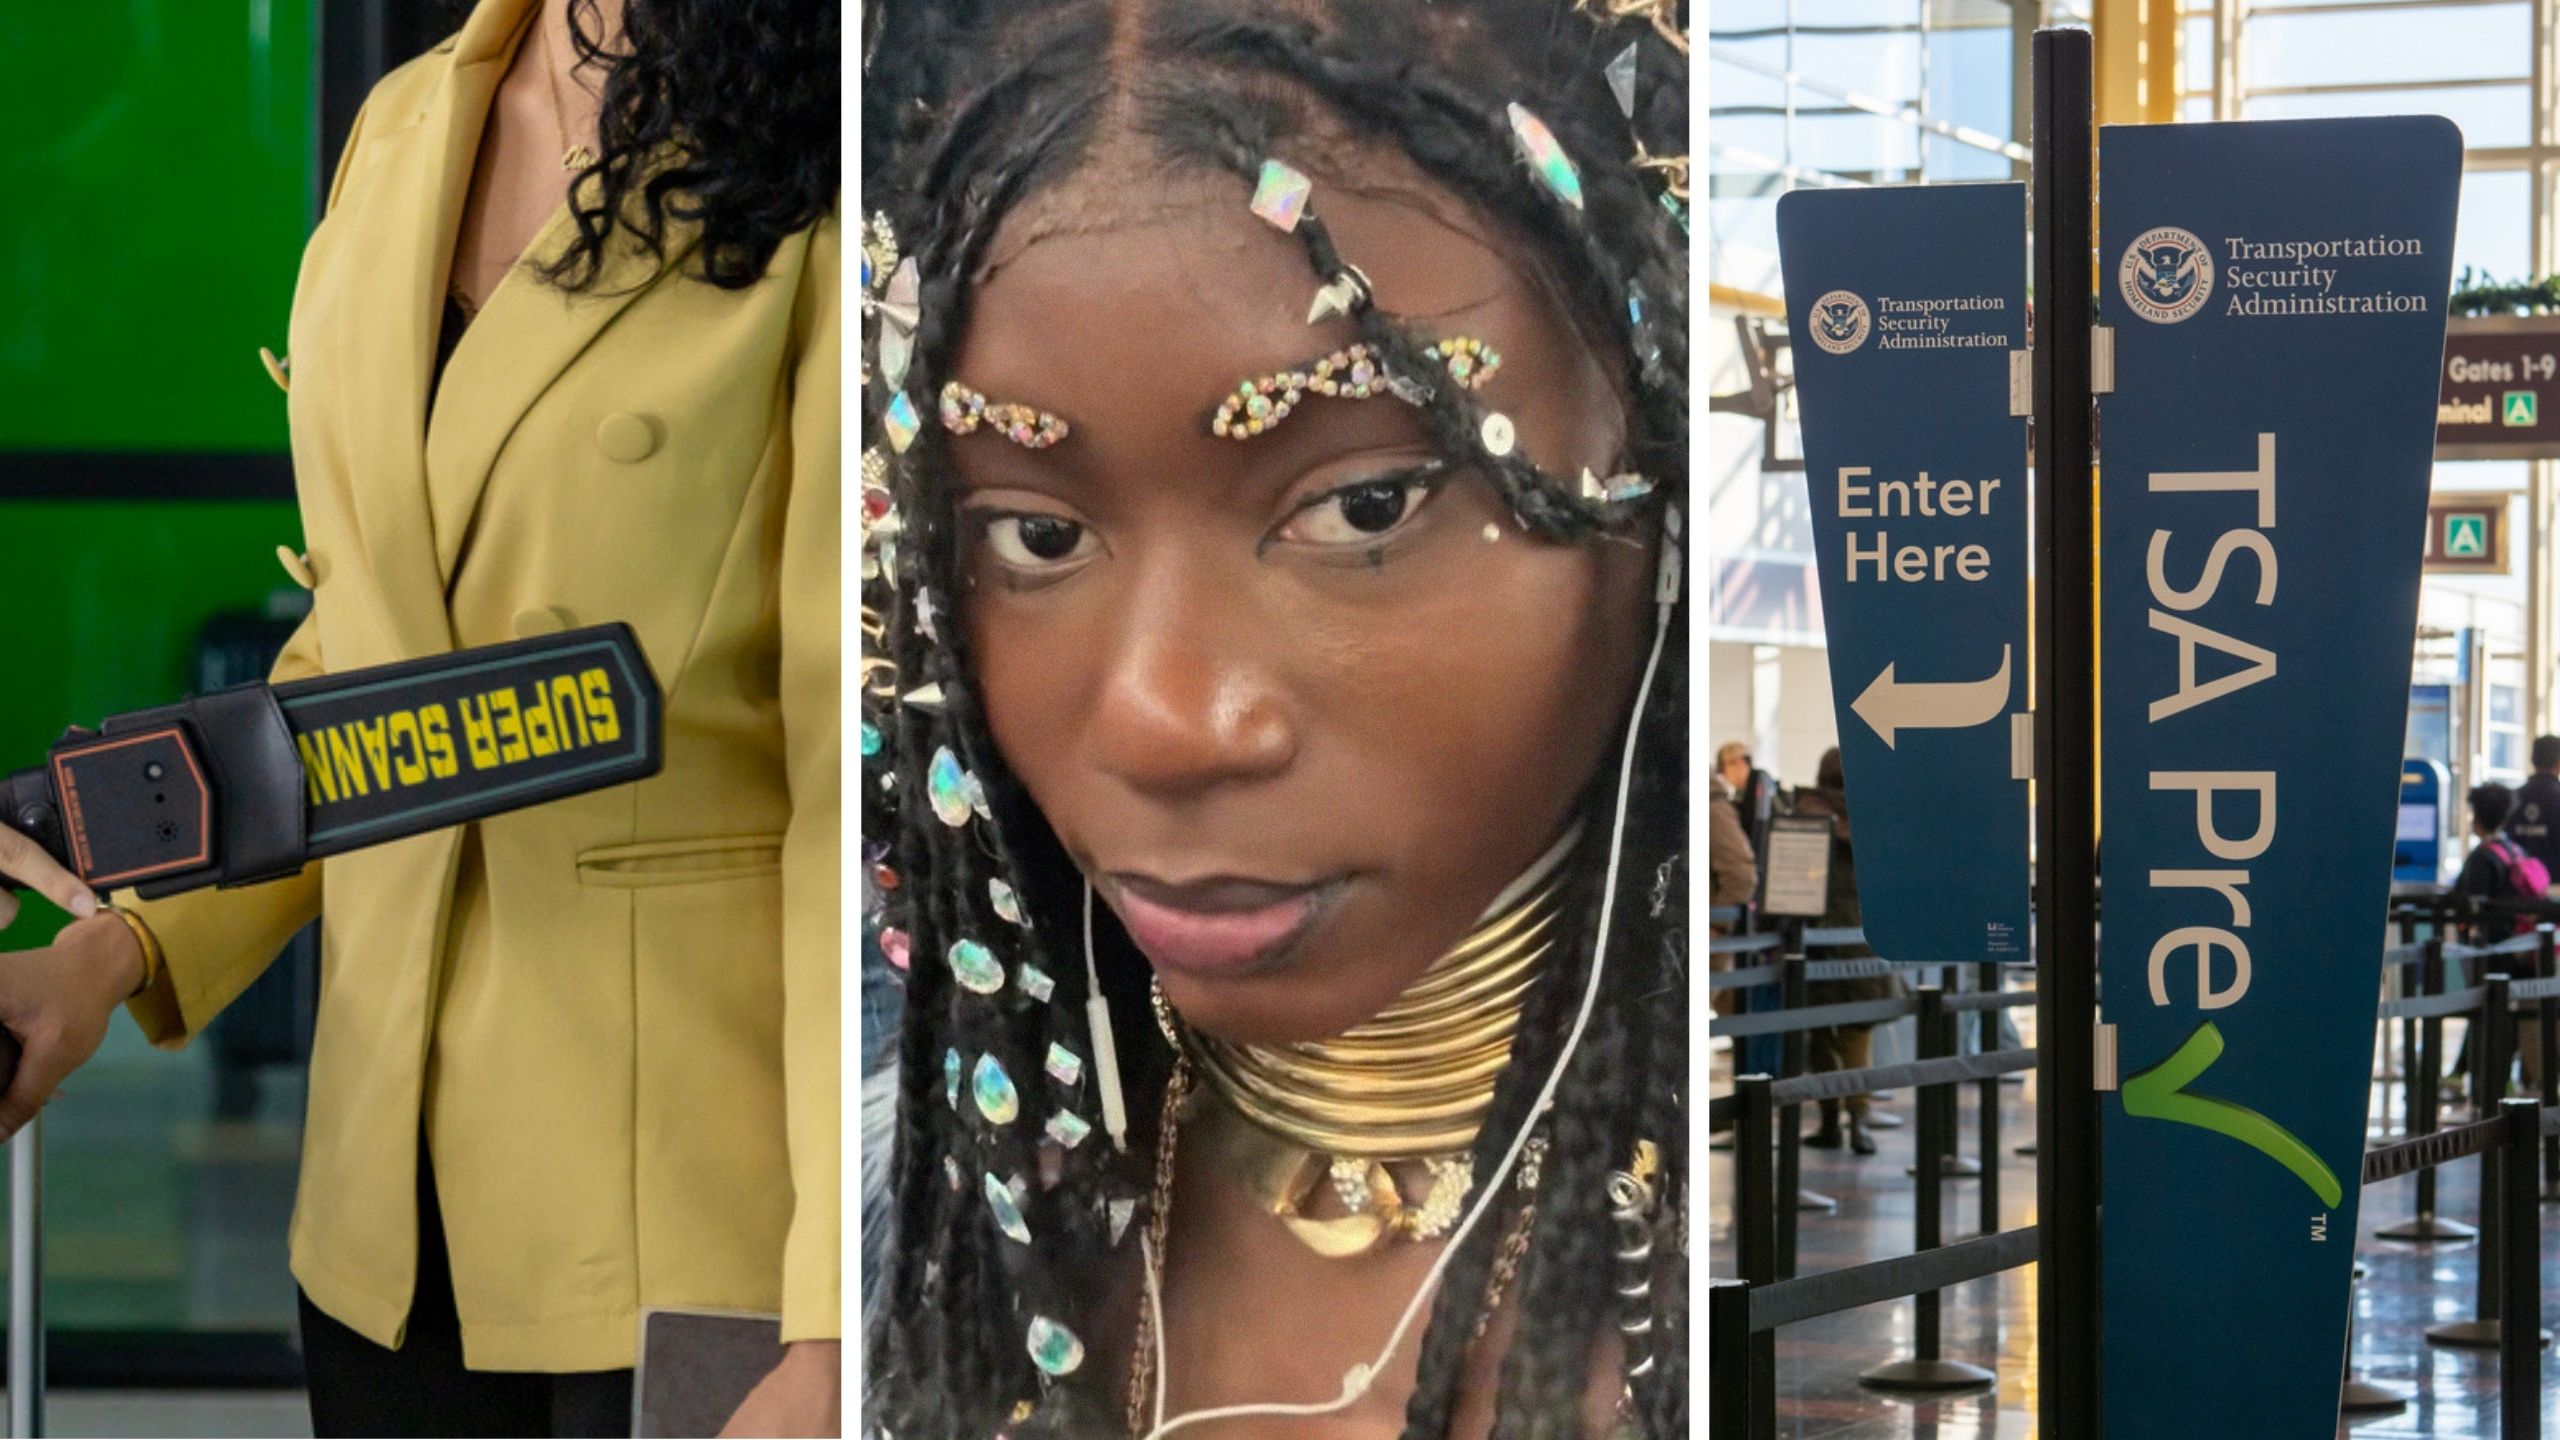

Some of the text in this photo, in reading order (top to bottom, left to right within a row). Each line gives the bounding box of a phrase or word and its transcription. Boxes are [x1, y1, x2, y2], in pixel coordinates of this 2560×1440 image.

[2225, 234, 2423, 265] Transportation
[2226, 265, 2337, 293] Security
[1877, 295, 2005, 316] Transportation
[2225, 290, 2428, 316] Administration
[1878, 315, 1950, 333] Security
[1877, 332, 2008, 350] Administration
[2448, 353, 2556, 383] Gates 1-9
[1838, 466, 2001, 518] Enter
[1846, 531, 1991, 583] Here
[458, 667, 621, 771] SUPER
[2145, 431, 2328, 1241] TSA Pre TM
